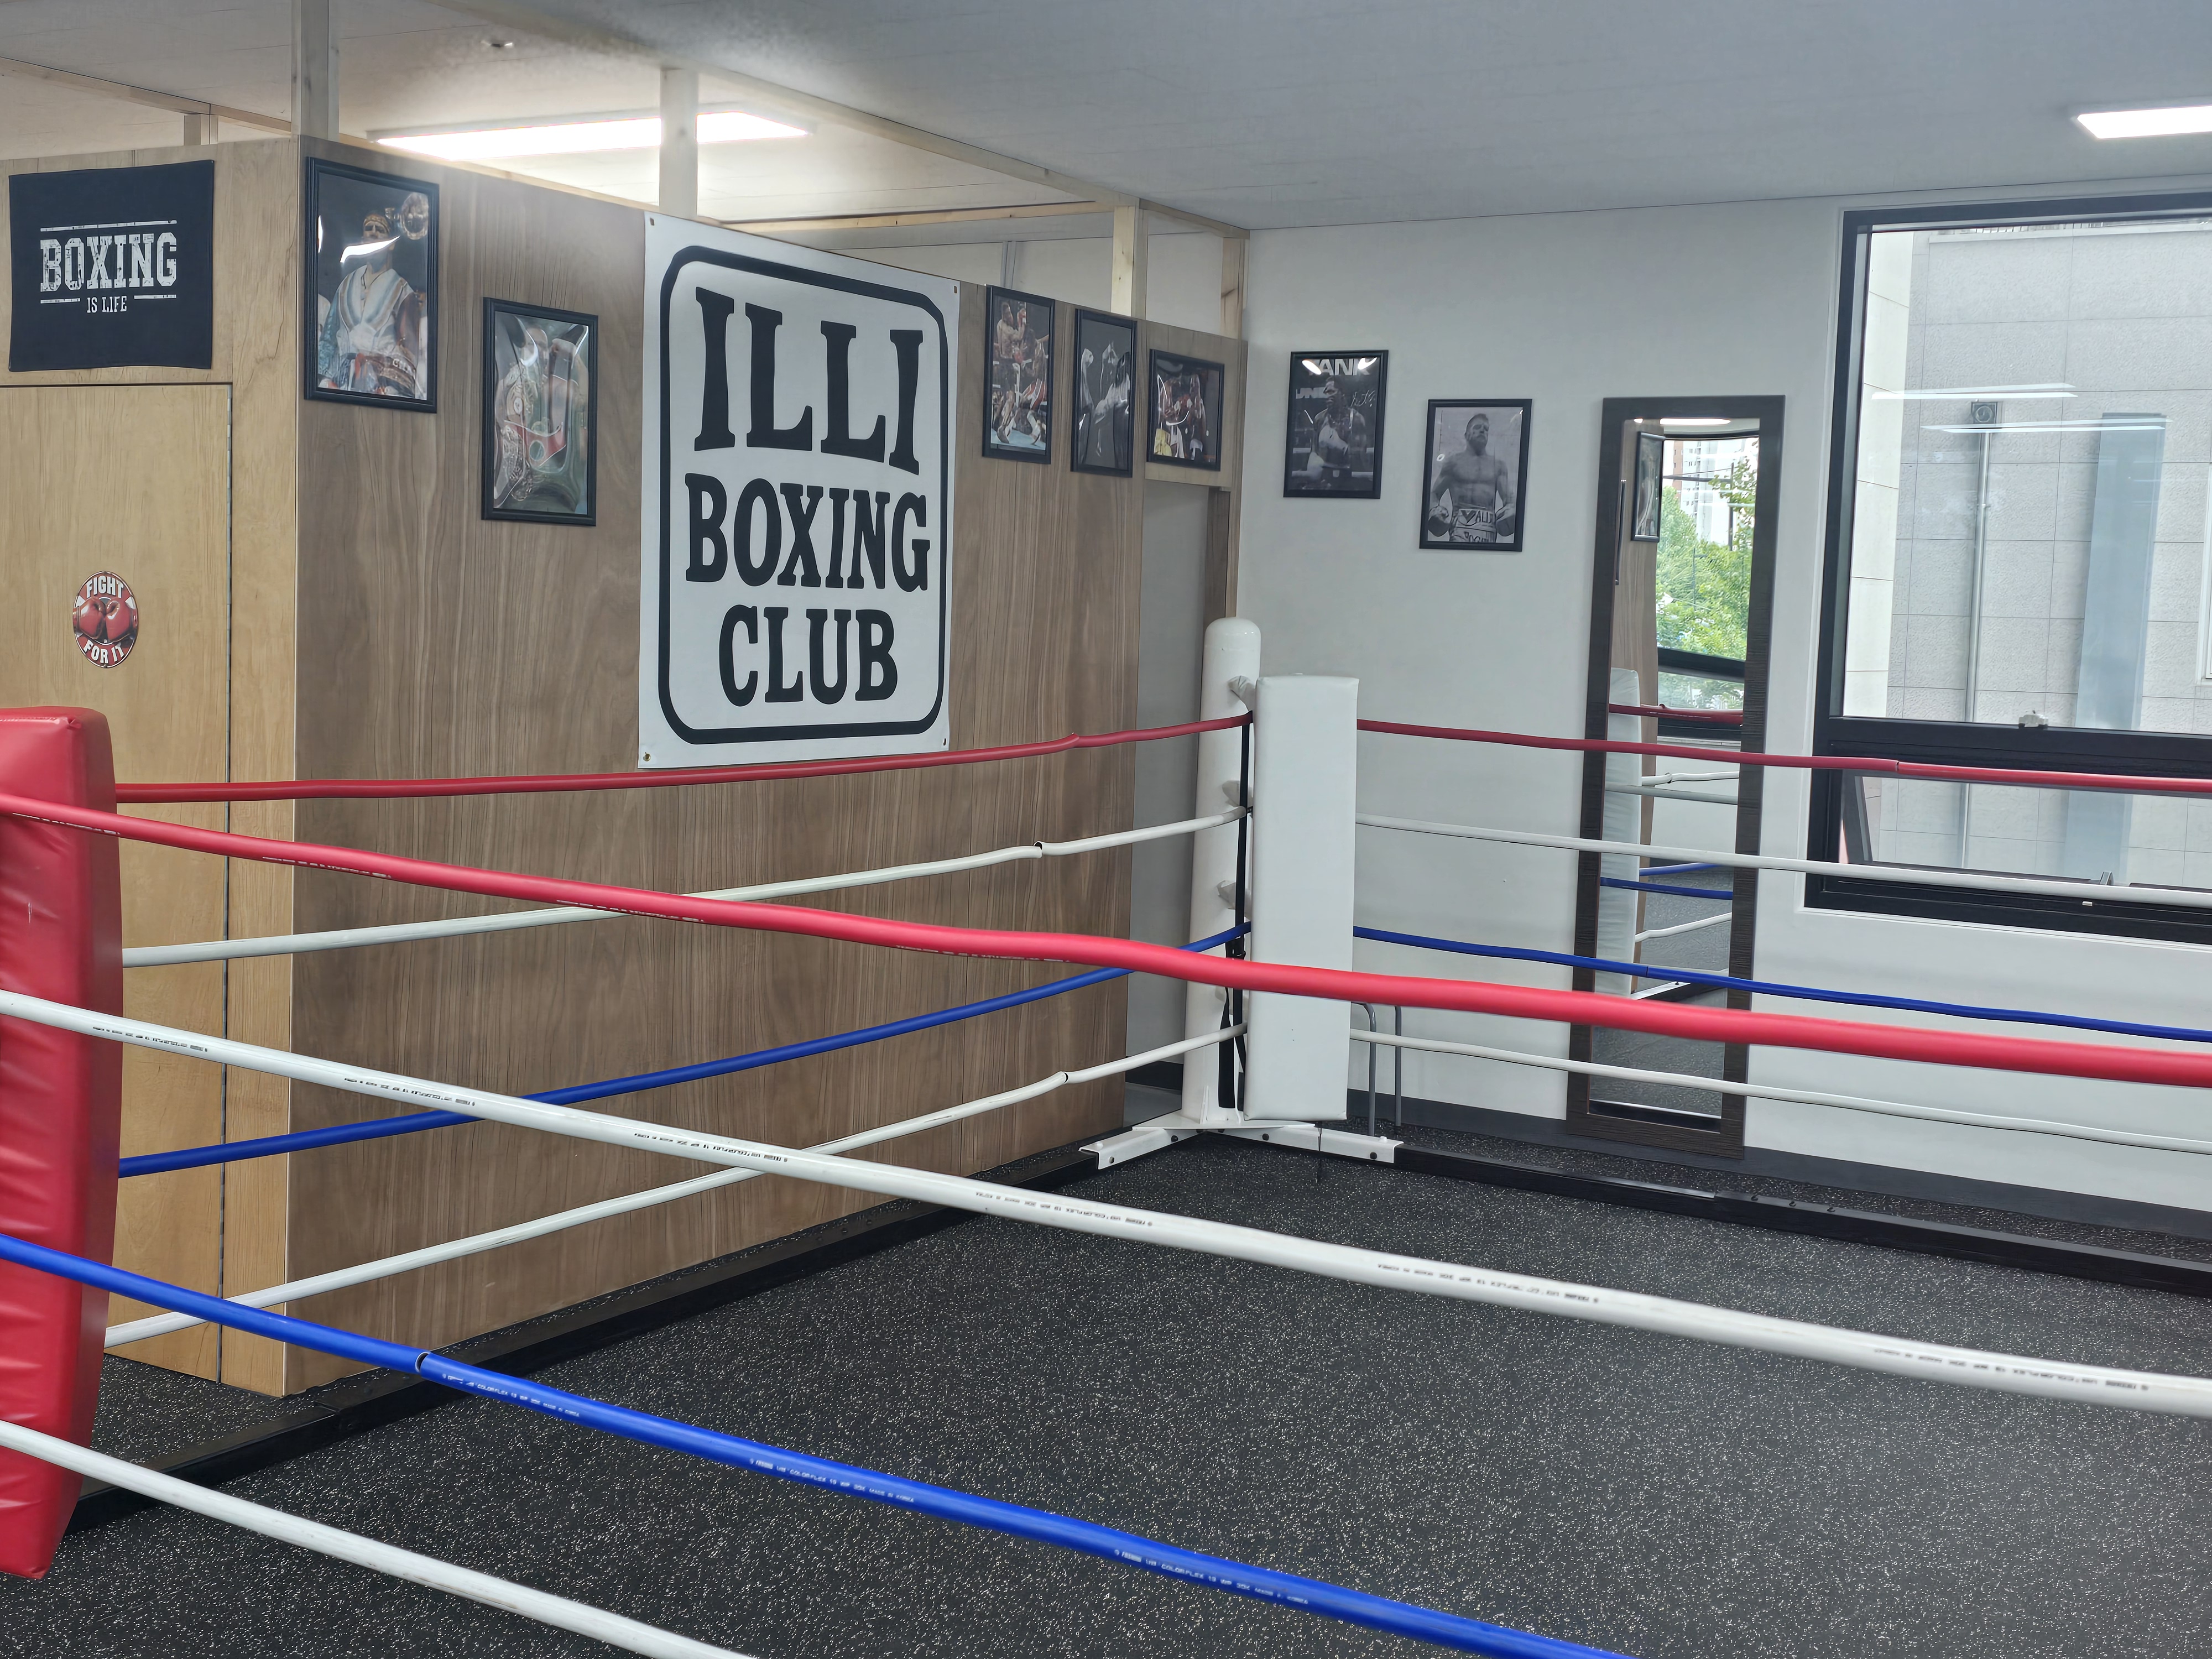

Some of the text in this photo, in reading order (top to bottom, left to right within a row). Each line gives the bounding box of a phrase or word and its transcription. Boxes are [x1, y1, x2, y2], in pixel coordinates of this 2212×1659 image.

[40, 232, 177, 291] BOXING
[87, 296, 127, 313] IS LIFE
[695, 287, 924, 475] ILLI
[685, 473, 931, 592] BOXING
[86, 576, 124, 598] FIGHT
[84, 640, 124, 664] FOR IT
[719, 604, 899, 707] CLUB
